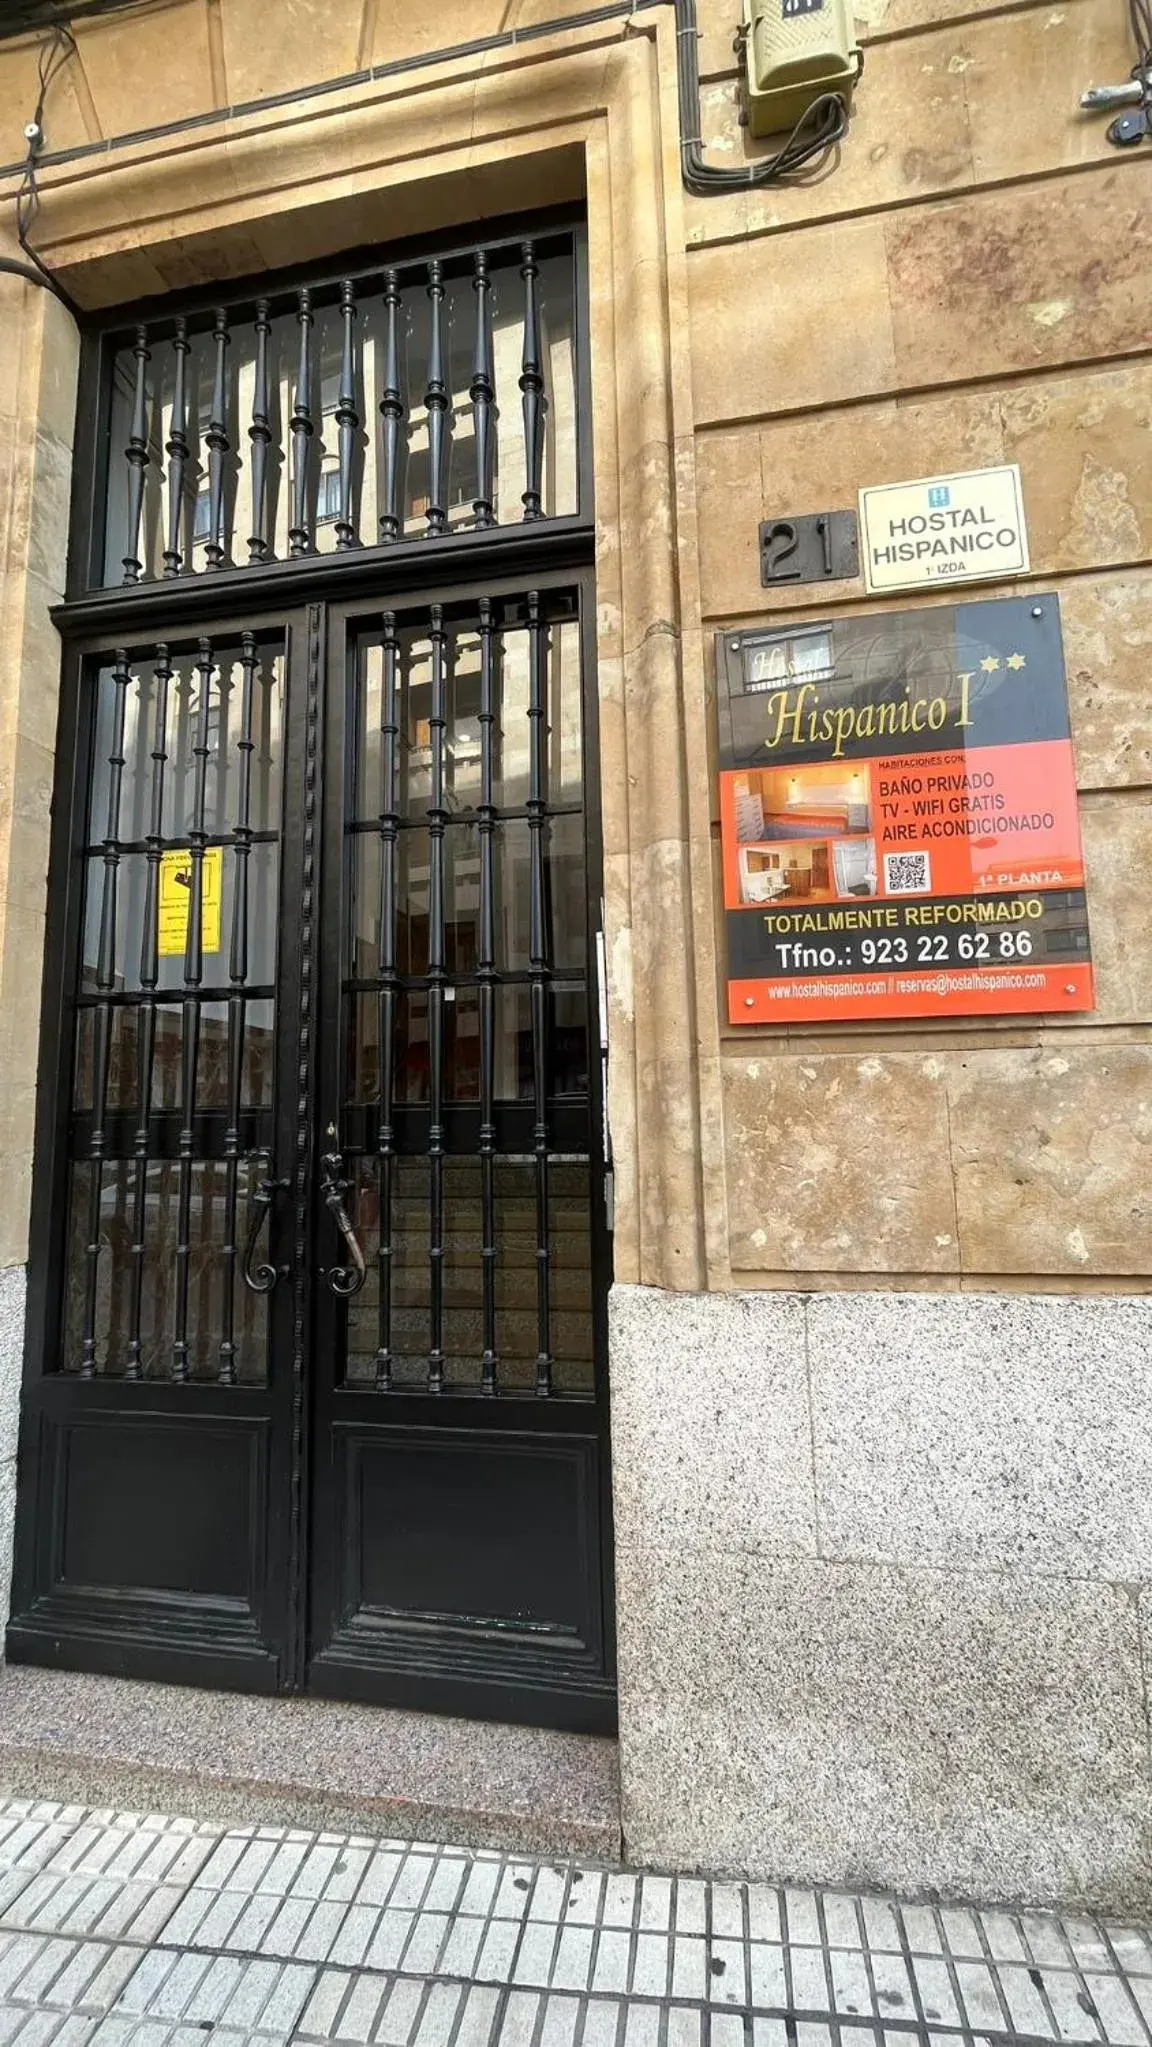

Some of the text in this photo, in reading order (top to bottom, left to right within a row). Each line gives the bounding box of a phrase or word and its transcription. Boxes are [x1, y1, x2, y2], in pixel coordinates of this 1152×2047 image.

[889, 506, 995, 537] HOSTAL
[764, 514, 832, 582] 21
[873, 527, 1016, 566] HISPANICO
[765, 671, 977, 757] Hispanico I
[878, 757, 942, 770] HABITACIONES
[879, 771, 995, 797] BAÑO PRIVADO
[880, 802, 899, 819] TV
[912, 799, 944, 817] WIFI
[948, 794, 1005, 814] GRATIS
[882, 812, 1055, 842] AIRE ACONDICIONADO
[998, 870, 1063, 885] PLANTA
[764, 899, 1043, 935] TOTALMENTE REFORMADO
[776, 931, 1033, 969] Tfno.: 923 22 62 86
[768, 978, 887, 1001] www.hostalhispanico.com
[896, 972, 1046, 996] reservas@hostalhispanico.com
